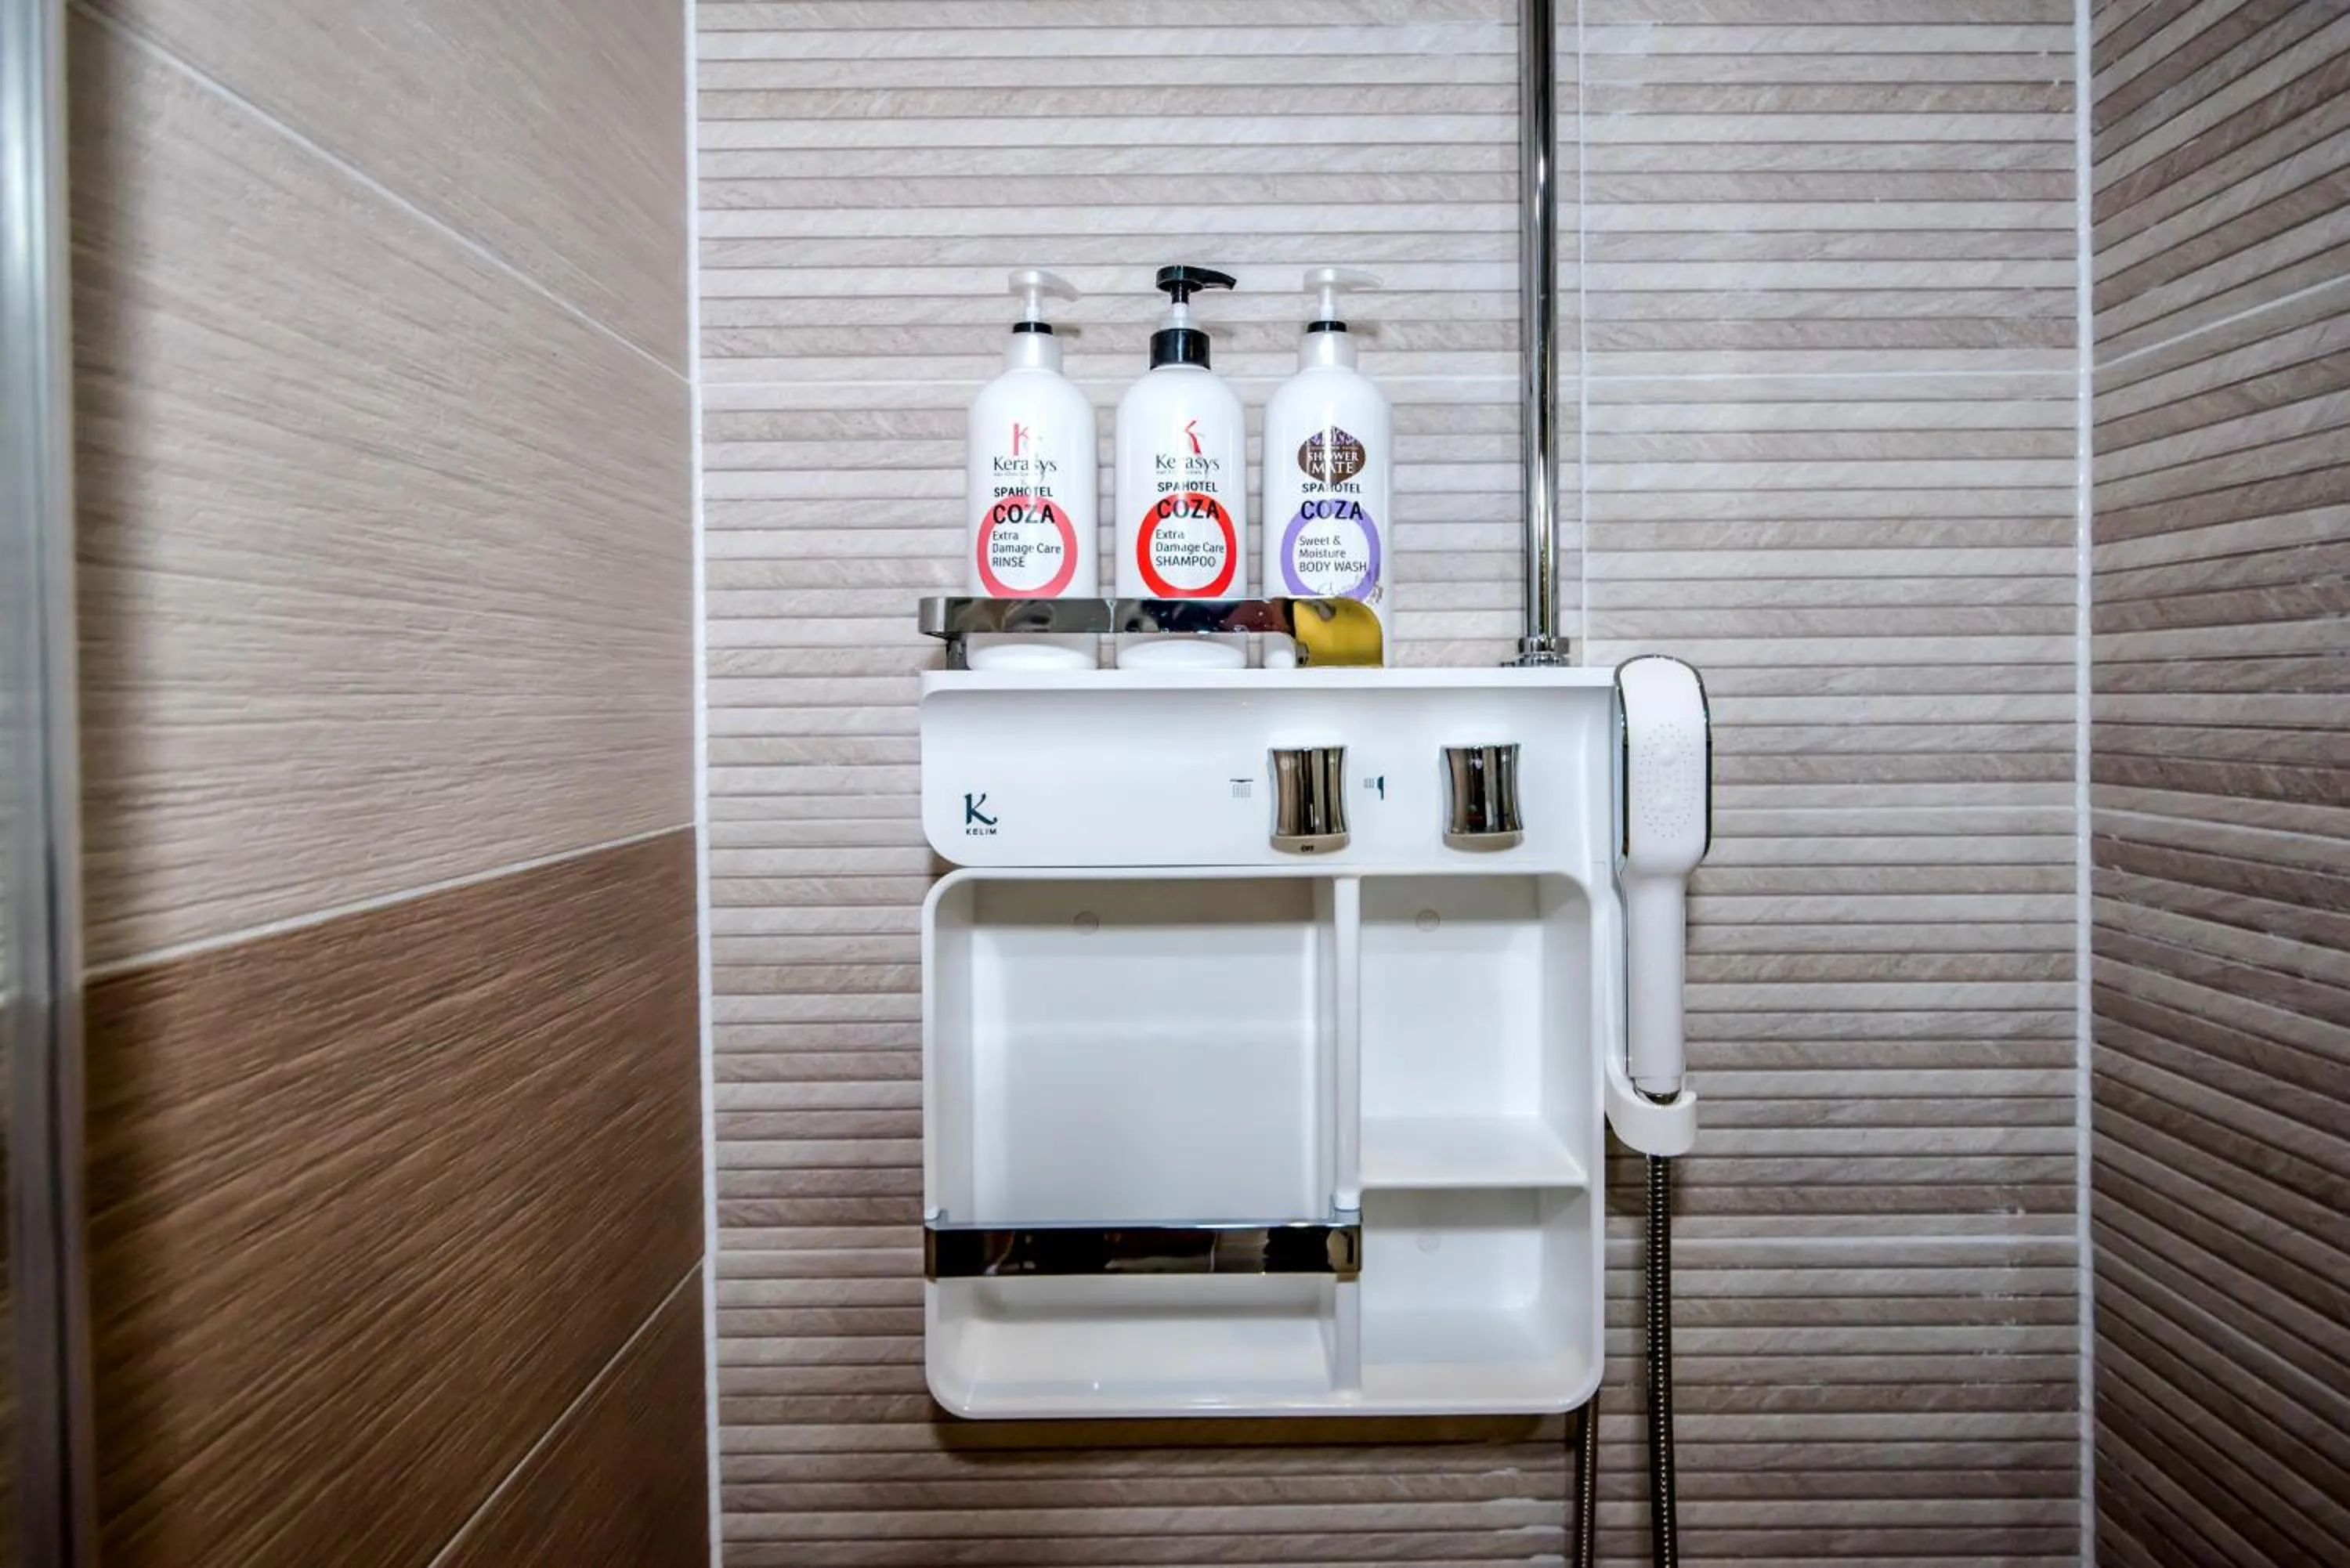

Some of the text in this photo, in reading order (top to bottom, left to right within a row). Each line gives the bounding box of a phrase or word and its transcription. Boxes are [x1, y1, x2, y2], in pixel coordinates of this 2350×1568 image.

[1307, 451, 1358, 461] SHWER
[993, 456, 1057, 482] Kerays
[1155, 453, 1220, 479] Keasys
[992, 504, 1055, 524] COZA
[1157, 499, 1219, 519] COZA
[1300, 500, 1363, 521] COZA
[992, 530, 1018, 540] Extra
[1155, 529, 1184, 540] Extra
[1300, 536, 1341, 546] Sweet &
[992, 544, 1061, 555] Damage Care
[1155, 542, 1224, 553] Damage Care
[1300, 549, 1346, 558] Moisture
[992, 556, 1025, 568] RINSE
[1155, 555, 1216, 567] SHAMPOO
[1300, 561, 1367, 573] BODY WASH
